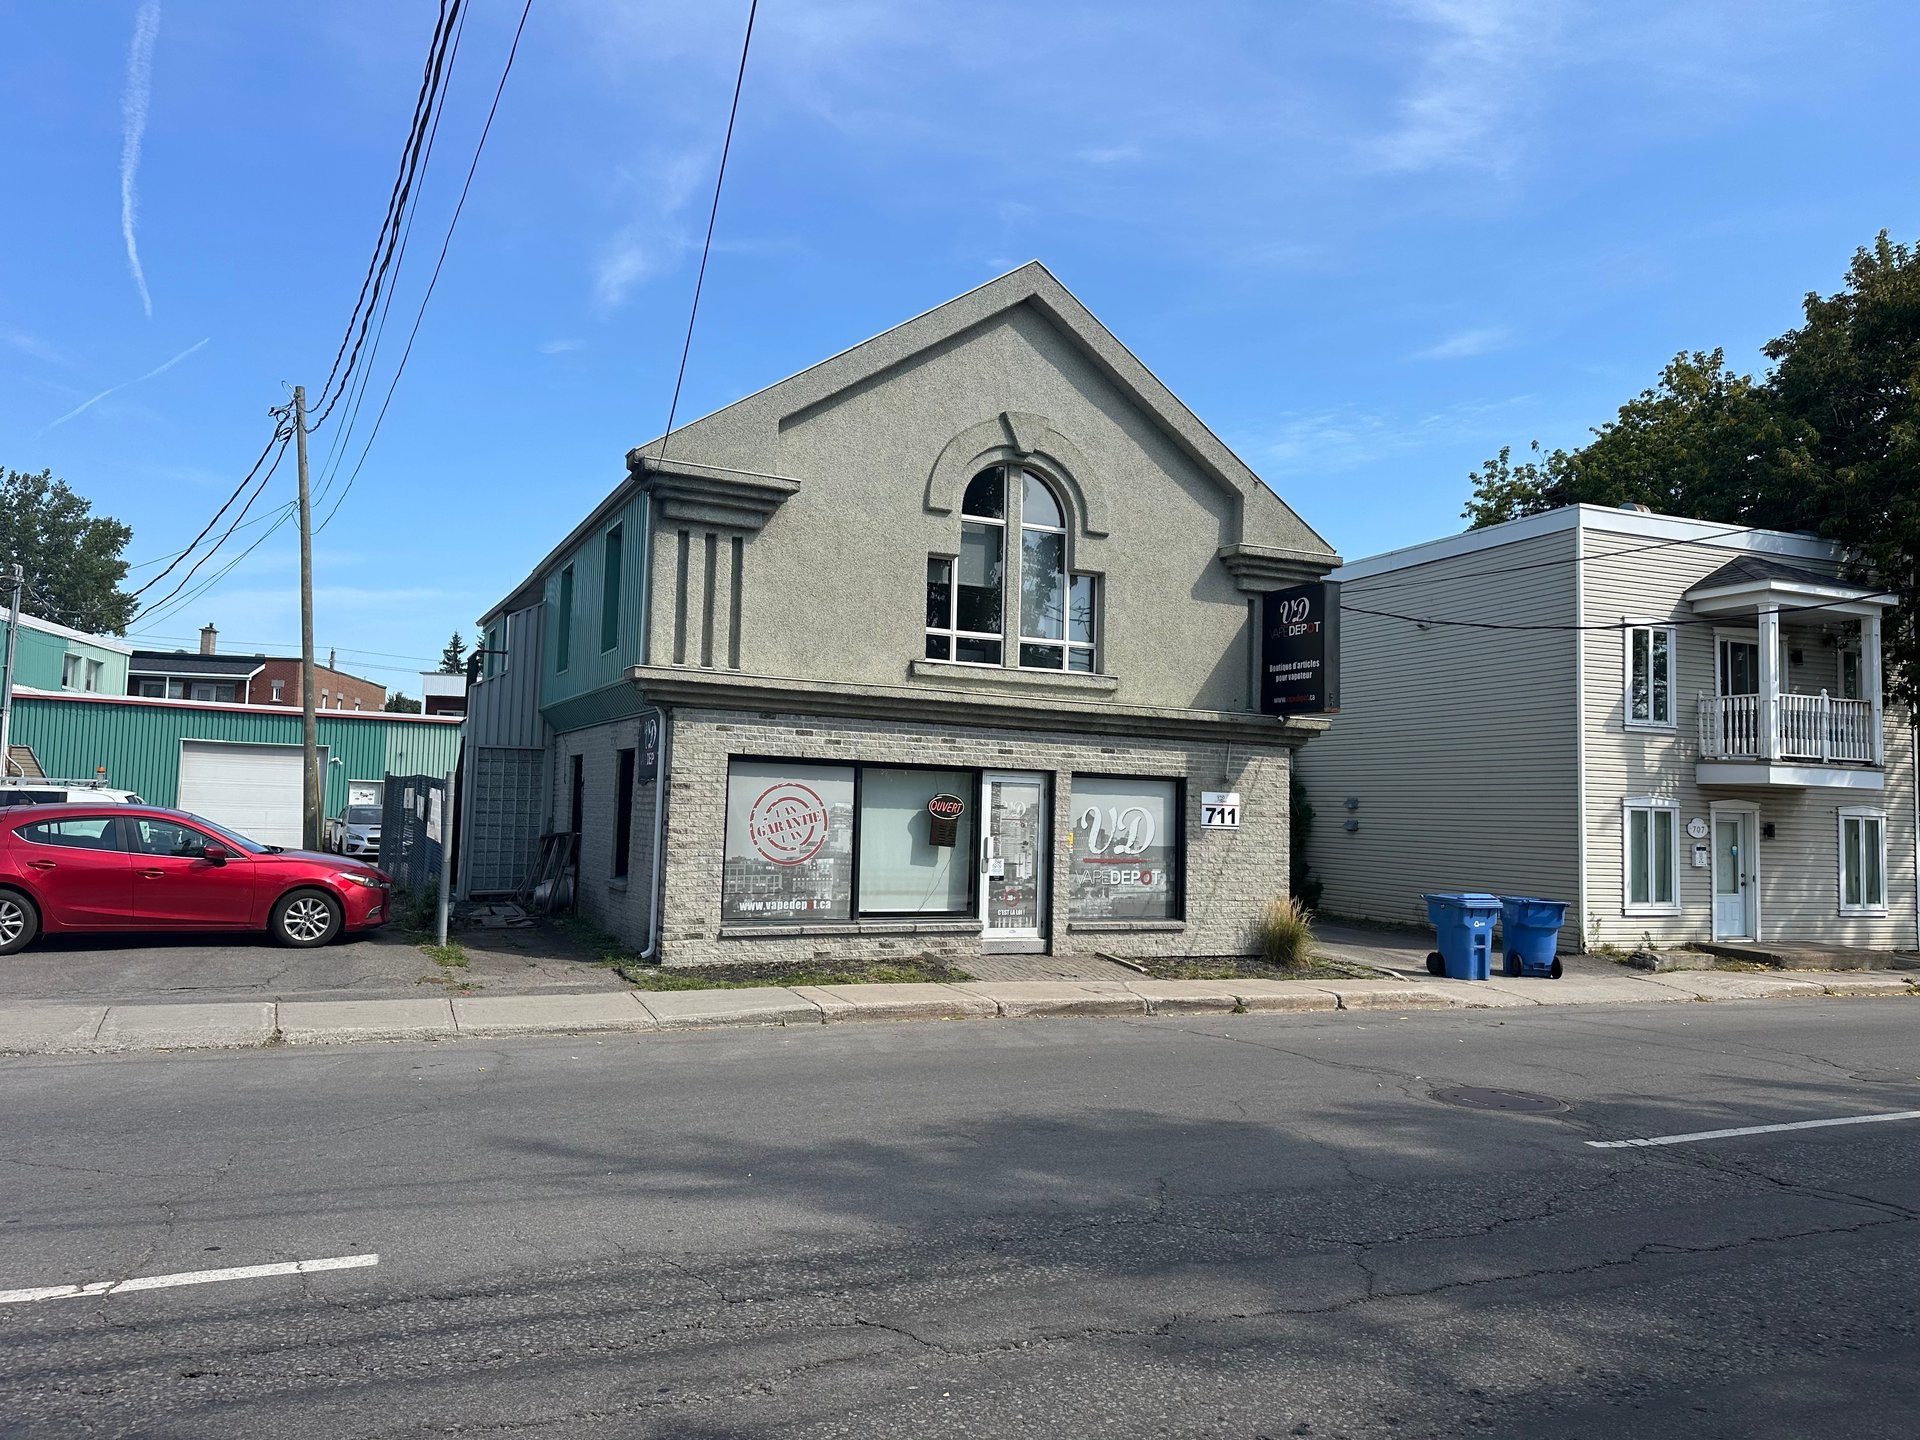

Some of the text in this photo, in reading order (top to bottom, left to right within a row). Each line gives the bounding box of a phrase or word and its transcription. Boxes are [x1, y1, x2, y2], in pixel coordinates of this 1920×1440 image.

[930, 800, 963, 813] OUVERT
[756, 811, 821, 837] GARANTIE
[1205, 807, 1236, 824] 711
[1081, 806, 1155, 855] VD
[1692, 826, 1705, 834] 707
